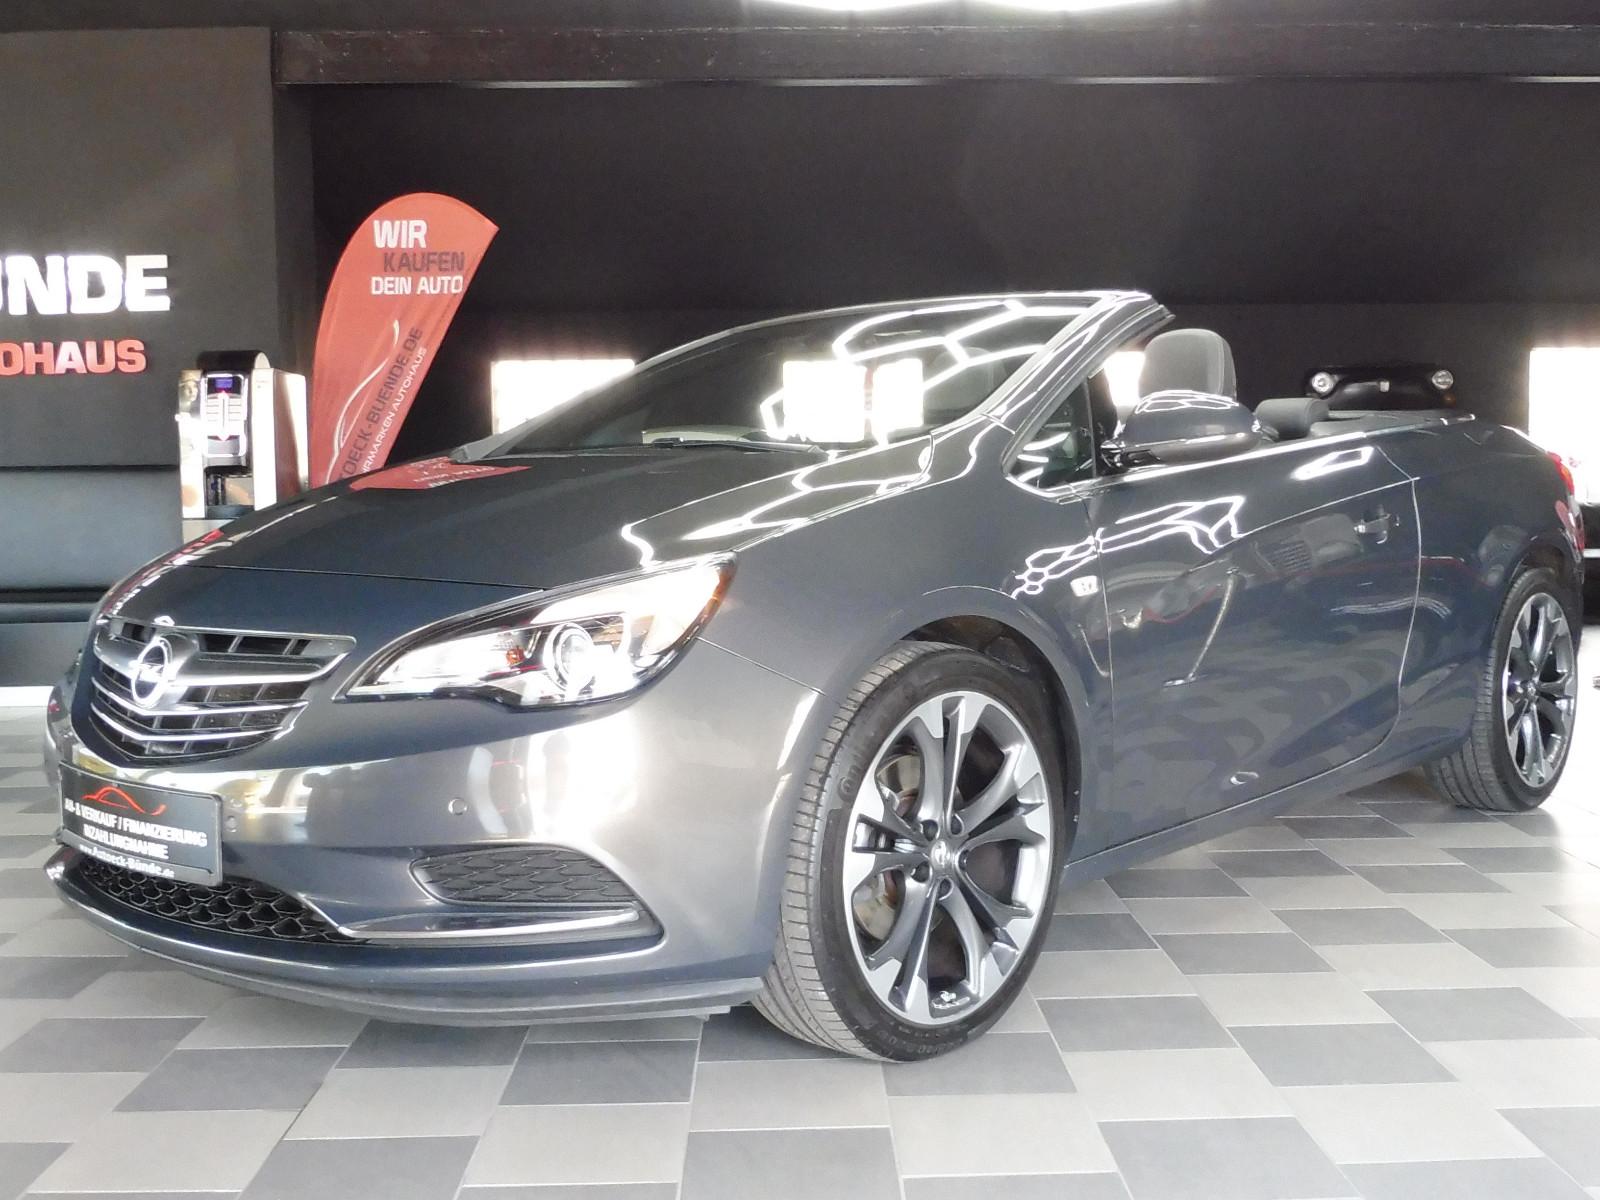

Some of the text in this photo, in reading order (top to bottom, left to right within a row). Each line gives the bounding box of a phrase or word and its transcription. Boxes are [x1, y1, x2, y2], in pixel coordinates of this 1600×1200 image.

[373, 219, 428, 249] WIR
[383, 251, 465, 273] KAUFEN
[0, 254, 171, 316] NDE
[371, 275, 464, 296] DEIN AUTO
[393, 347, 427, 412] AUTOHAUS
[81, 804, 117, 828] VERKAUF
[123, 817, 208, 848] FINANZIERUNG
